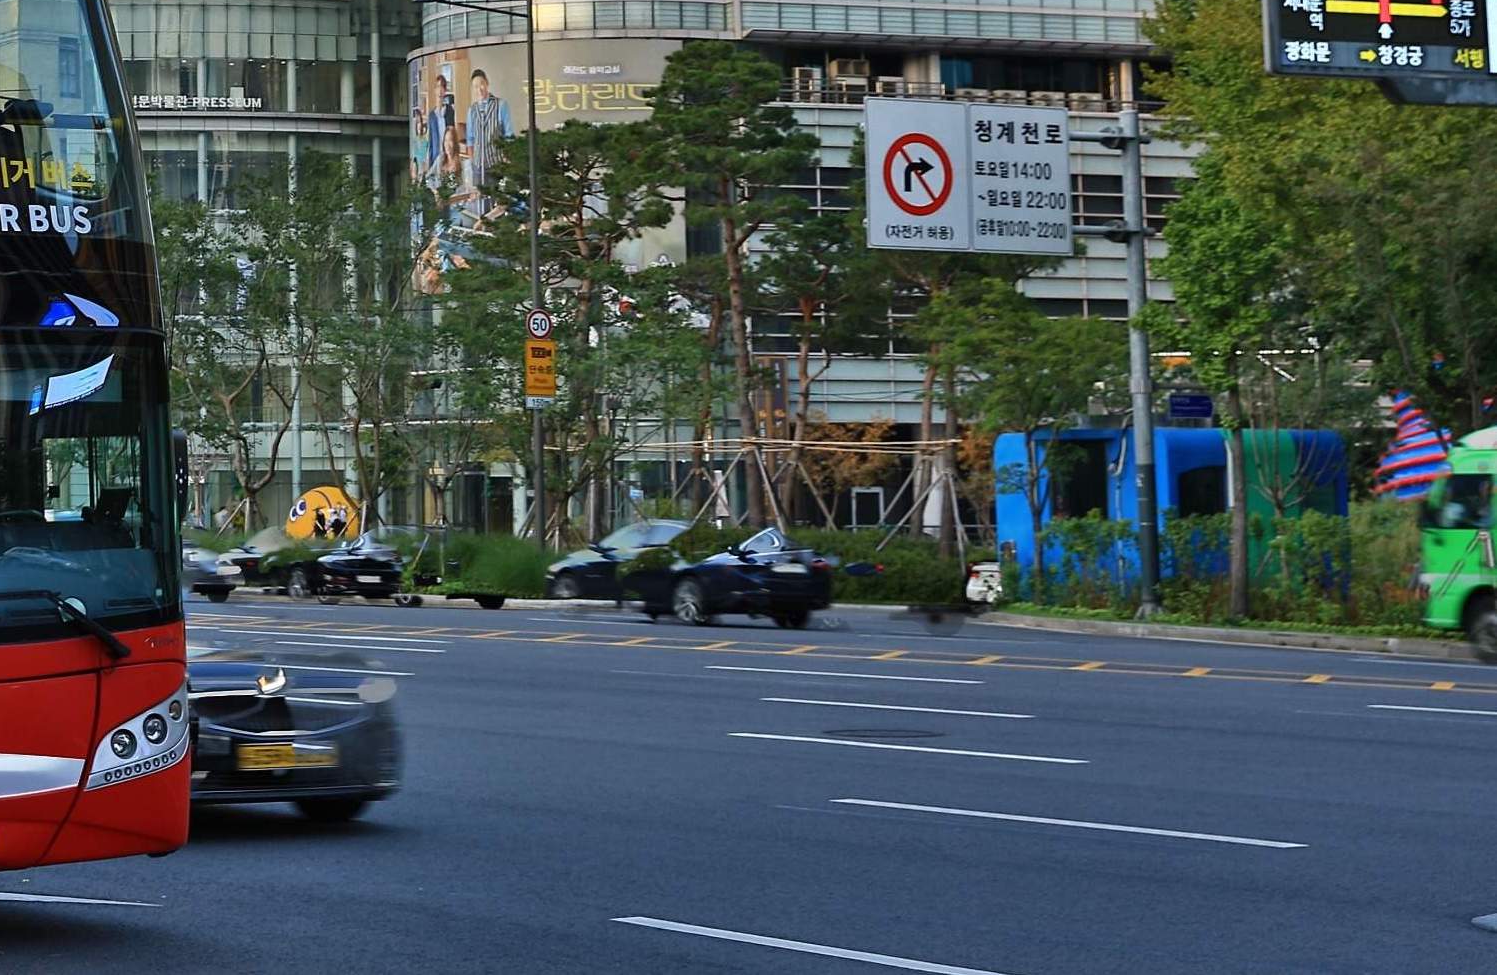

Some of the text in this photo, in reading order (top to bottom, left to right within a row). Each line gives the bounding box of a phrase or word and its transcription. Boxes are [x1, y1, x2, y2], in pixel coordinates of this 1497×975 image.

[1449, 0, 1476, 18] 종로
[1309, 13, 1324, 32] 역
[1449, 18, 1471, 37] 5가
[1284, 41, 1485, 69] 광화문 창경궁 서행
[132, 95, 263, 109] 문박물관 PRESSEUM
[974, 120, 1064, 145] 청계천로
[43, 158, 95, 191] 버스
[974, 160, 1052, 180] 토요일 14:00
[1026, 192, 1067, 210] 22:00
[29, 203, 92, 234] BUS
[885, 223, 955, 241] (자전거 허용)
[532, 318, 547, 331] 50
